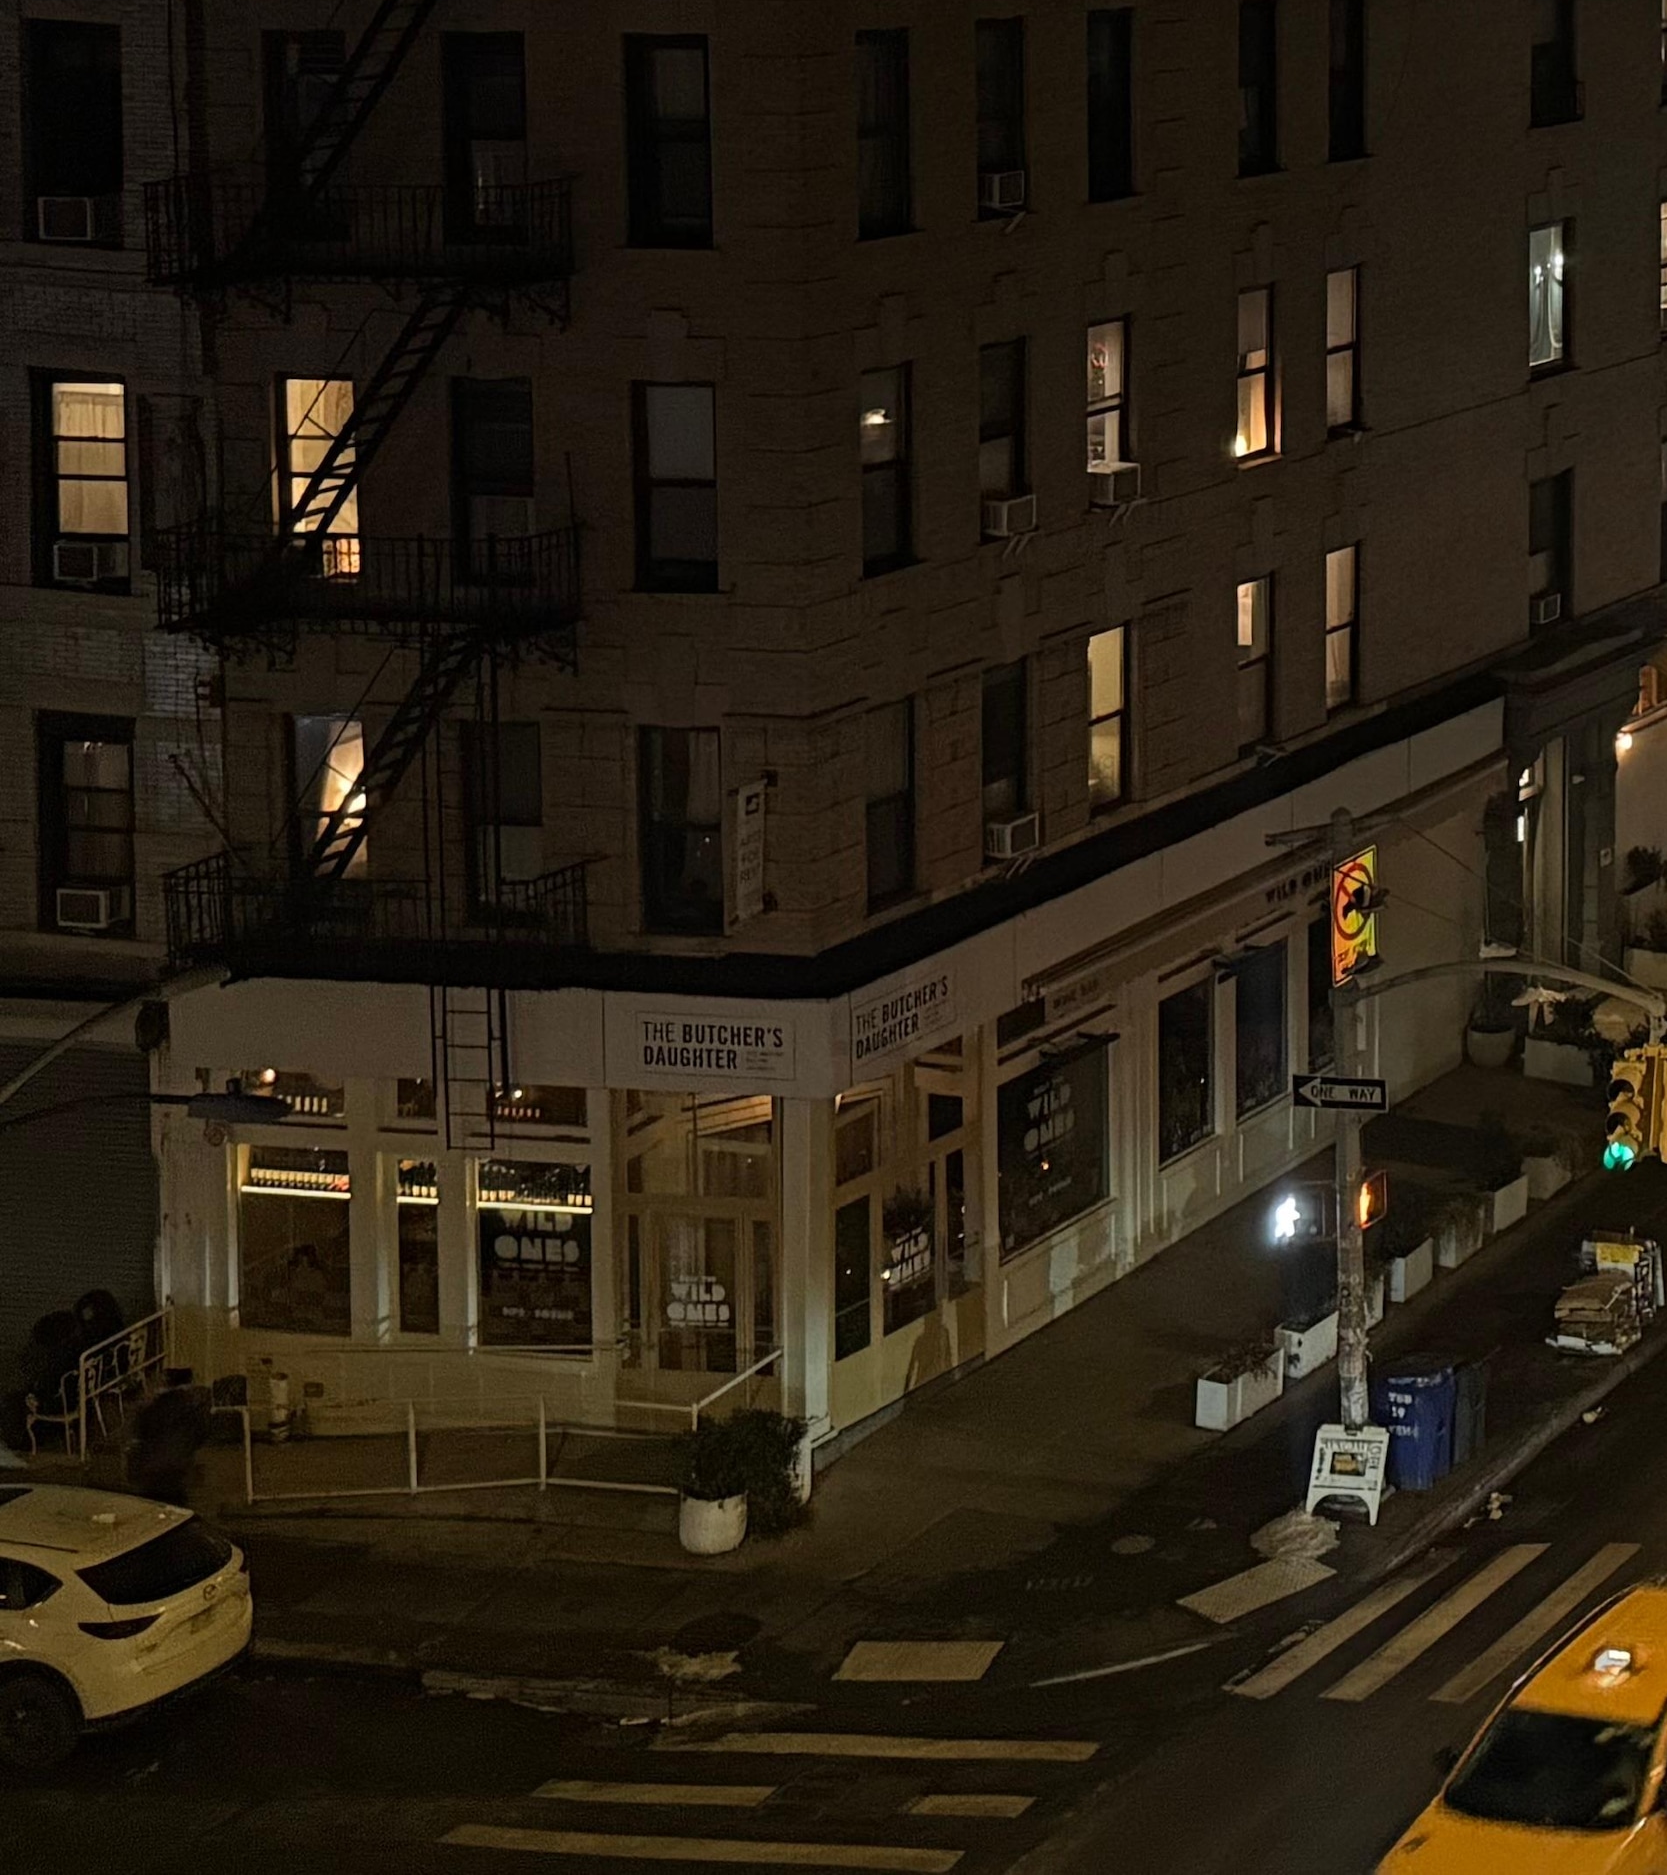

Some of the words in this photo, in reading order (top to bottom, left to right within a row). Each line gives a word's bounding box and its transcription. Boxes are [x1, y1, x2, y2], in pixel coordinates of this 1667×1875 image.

[1302, 861, 1332, 888] ONE
[855, 1006, 879, 1035] THE
[881, 976, 948, 1024] BUTCHER'S
[643, 1021, 675, 1044] THE
[682, 1023, 783, 1048] BUTCHER'S
[855, 1013, 920, 1059] DAUGHTER
[643, 1046, 738, 1070] DAUGHTER
[1310, 1084, 1335, 1099] ONE
[1348, 1086, 1377, 1101] WAY
[494, 1234, 581, 1263] ONES
[670, 1282, 726, 1303] WILD
